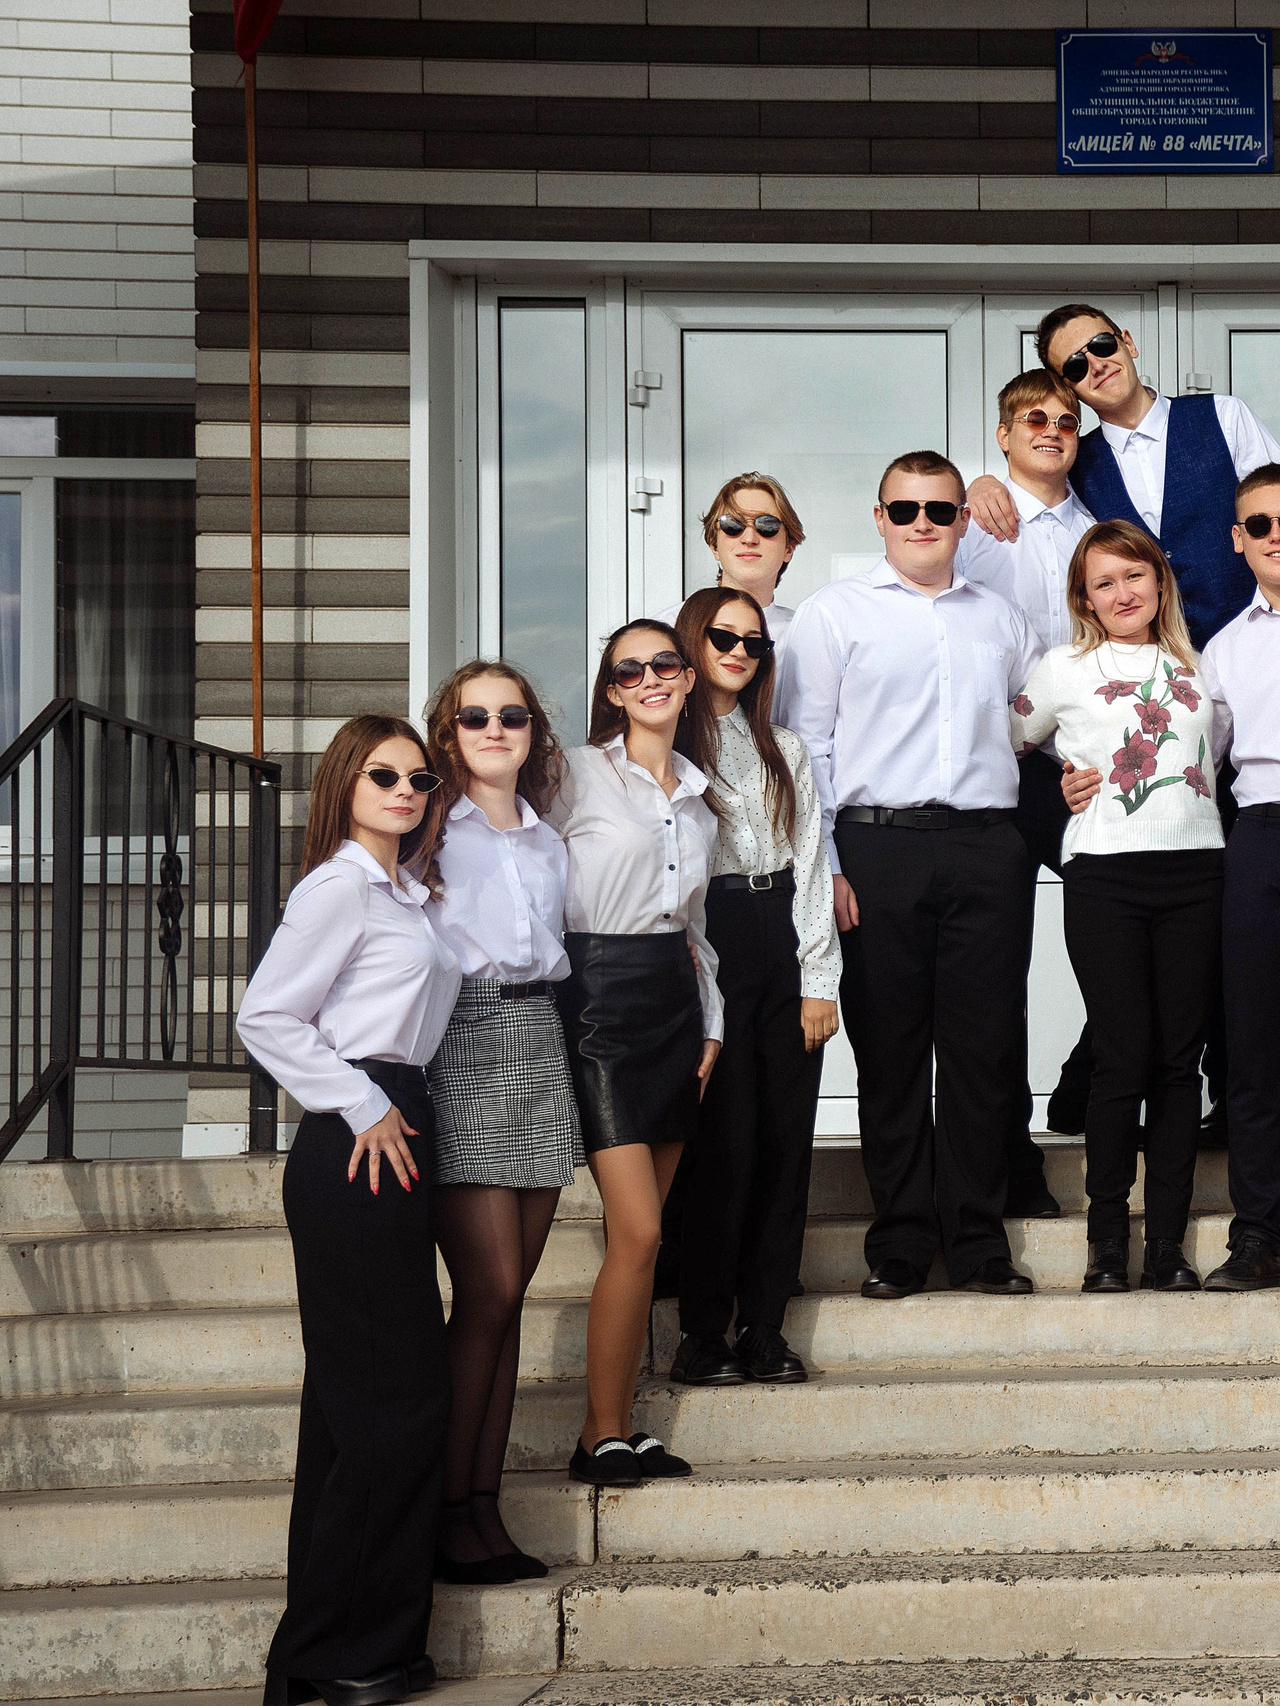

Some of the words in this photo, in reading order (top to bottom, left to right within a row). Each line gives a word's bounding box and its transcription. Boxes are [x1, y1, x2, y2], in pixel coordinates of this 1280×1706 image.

[1089, 98, 1177, 106] МУНИЦИПАЛЬНОЕ
[1179, 98, 1240, 106] БЮДЖЕТНОЕ
[1071, 107, 1189, 116] ОБЩЕОБРАЗОВАТЕЛЬНОЕ
[1191, 107, 1256, 116] УЧРЕЖДЕНИЕ
[1120, 117, 1156, 125] ГОРОДА
[1159, 117, 1207, 125] ГОРЛОВКИ
[1067, 132, 1134, 154] «ЛИЦЕЙ
[1139, 135, 1157, 151] №
[1163, 134, 1185, 151] 88
[1189, 134, 1263, 151] «МЕЧТА»
